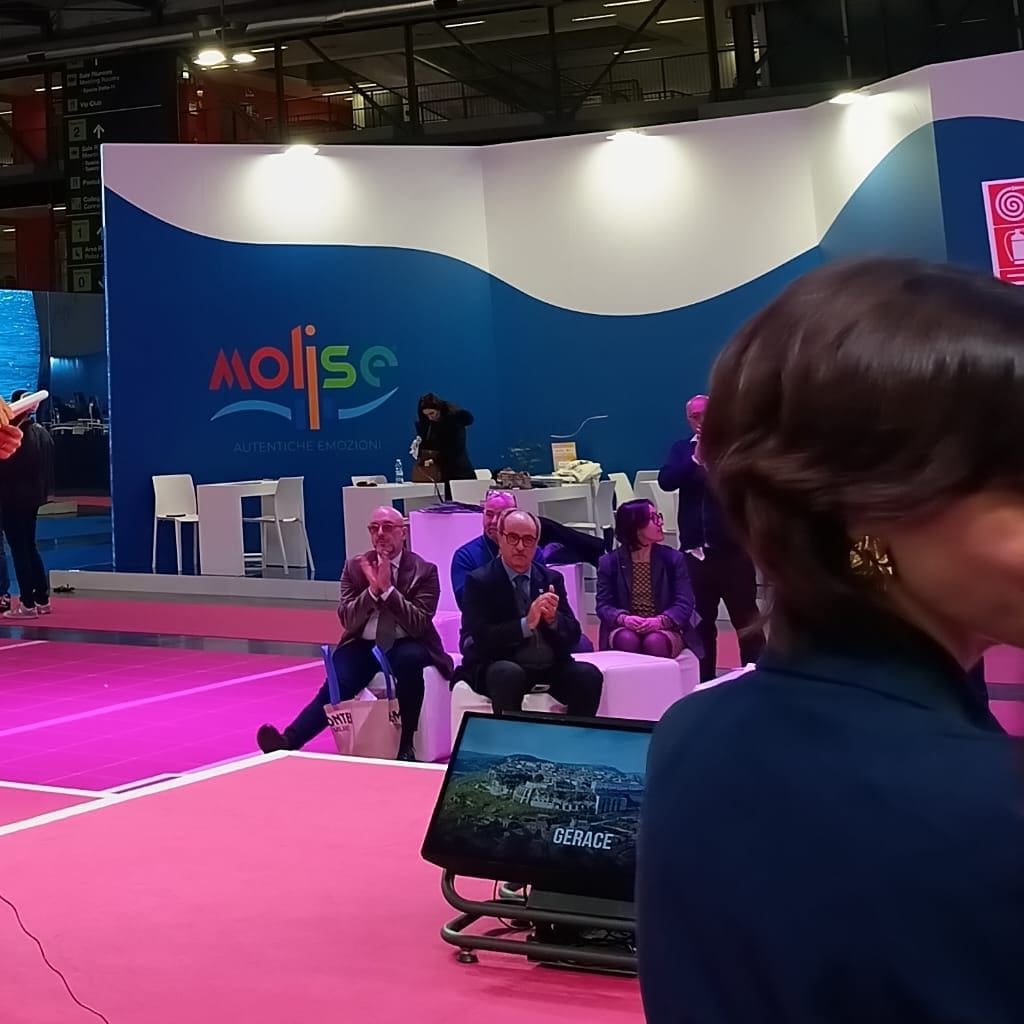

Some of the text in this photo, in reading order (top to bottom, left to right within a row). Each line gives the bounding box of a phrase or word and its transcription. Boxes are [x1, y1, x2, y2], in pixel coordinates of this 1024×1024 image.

[73, 126, 81, 138] 2
[232, 439, 382, 453] AUTENTICHE EMOZIONI
[552, 827, 614, 850] GERACE
